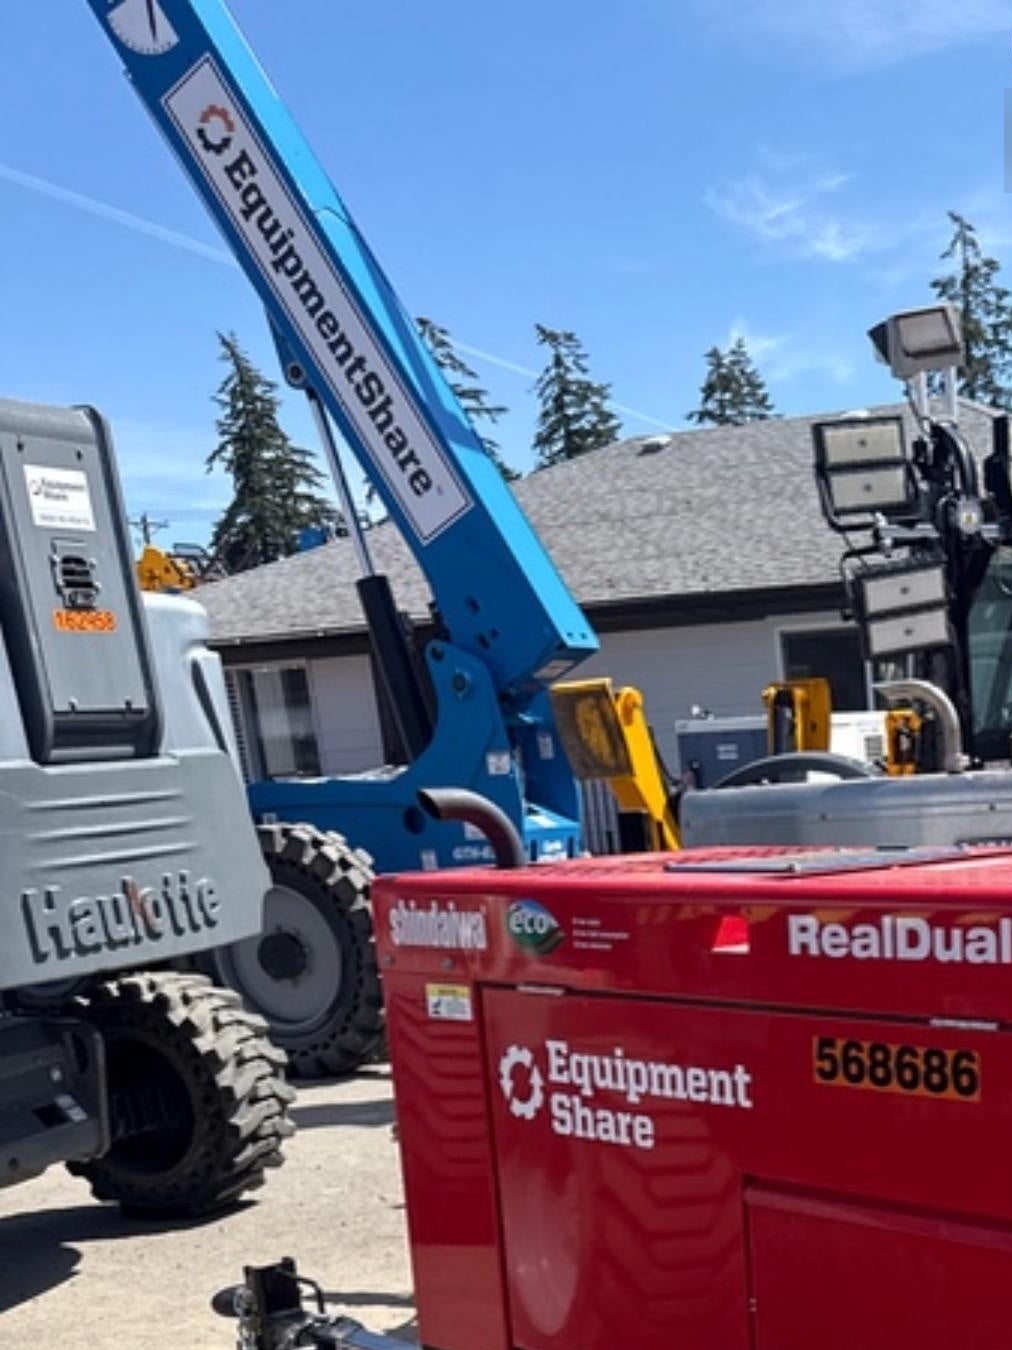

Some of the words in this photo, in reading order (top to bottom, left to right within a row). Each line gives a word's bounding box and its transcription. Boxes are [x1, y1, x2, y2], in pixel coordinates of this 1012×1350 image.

[224, 149, 433, 498] EquipmentShare
[20, 868, 223, 964] Haulotte
[510, 906, 549, 935] eco
[545, 1039, 753, 1109] Equipment
[815, 1036, 980, 1097] 568686
[552, 1093, 655, 1149] Share
